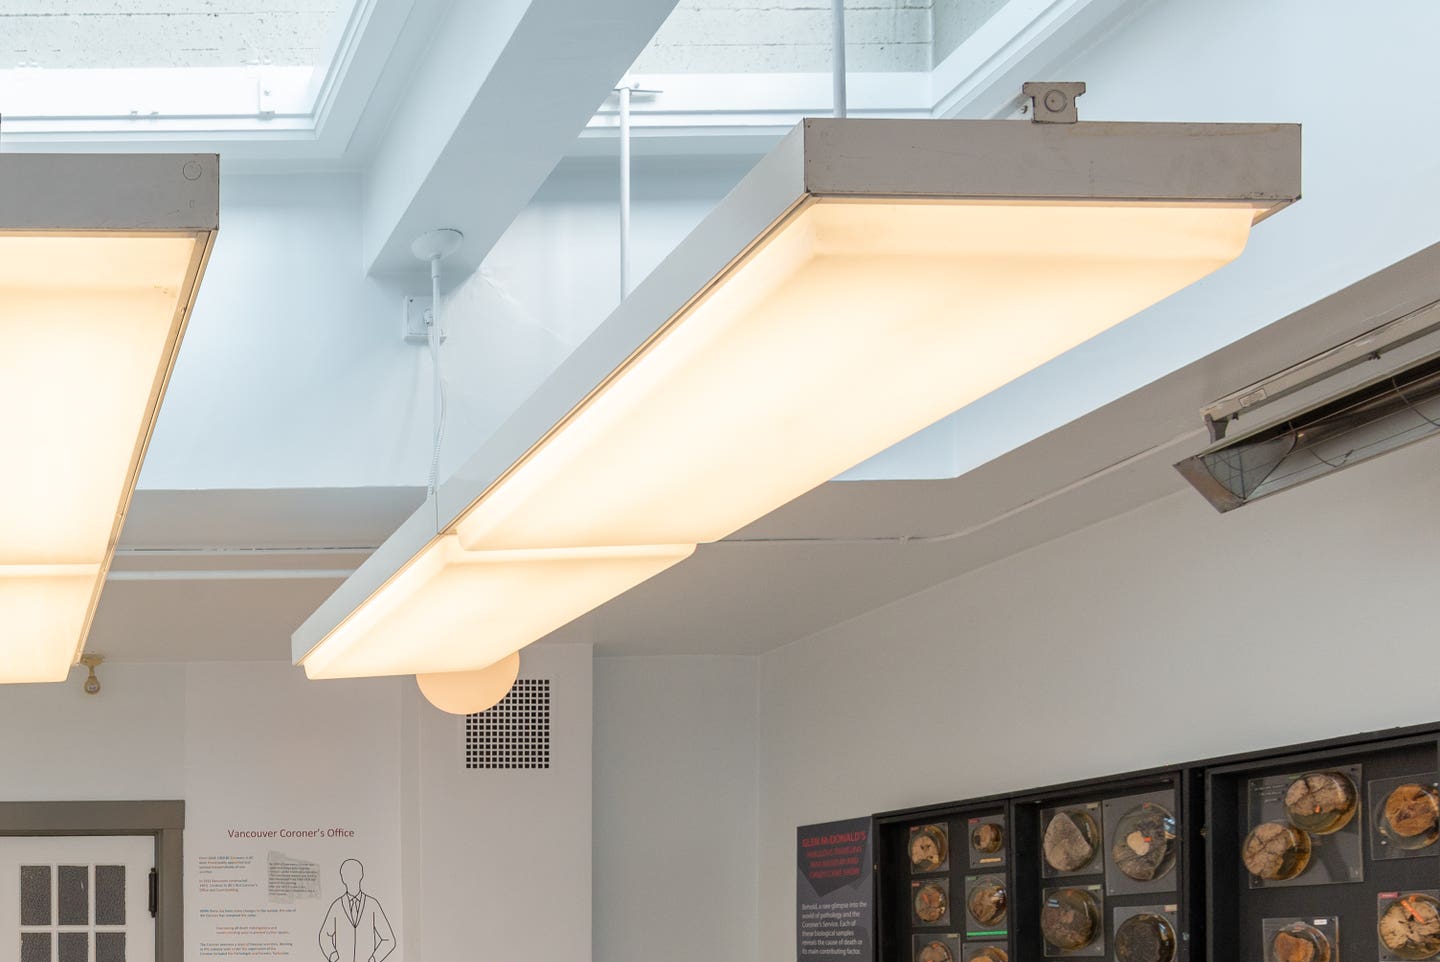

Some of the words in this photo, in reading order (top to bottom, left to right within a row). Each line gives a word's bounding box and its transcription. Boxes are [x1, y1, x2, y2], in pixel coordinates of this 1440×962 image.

[228, 829, 277, 838] Vancouver
[279, 828, 325, 838] Coroner's
[327, 828, 355, 838] Office
